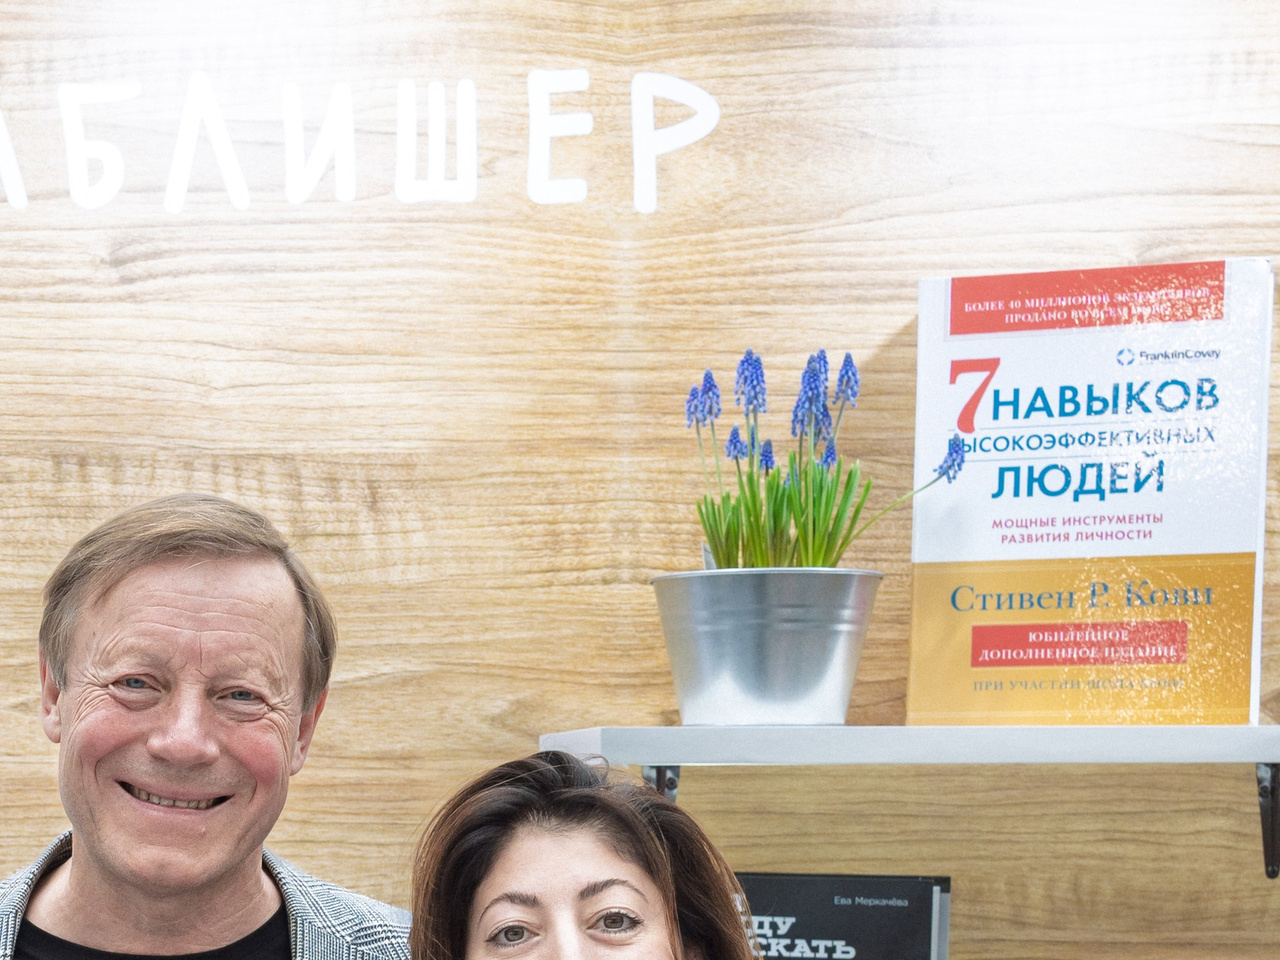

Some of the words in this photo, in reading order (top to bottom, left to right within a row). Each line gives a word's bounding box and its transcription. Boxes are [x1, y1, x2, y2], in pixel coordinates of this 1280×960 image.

[964, 300, 1005, 313] БОЛЕЕ
[949, 357, 1001, 434] 7
[991, 377, 1220, 421] НАВЫКОВ
[991, 450, 1165, 502] ЛЮДЕЙ
[991, 516, 1058, 530] МОЩНЫЕ
[1061, 513, 1164, 528] ИНСТРУМЕНТЫ
[1001, 531, 1071, 544] РАЗВИТИЯ
[1074, 529, 1153, 542] ЛИЧНОСТИ
[833, 896, 852, 906] Ева
[748, 937, 857, 960] СКАТЬ
